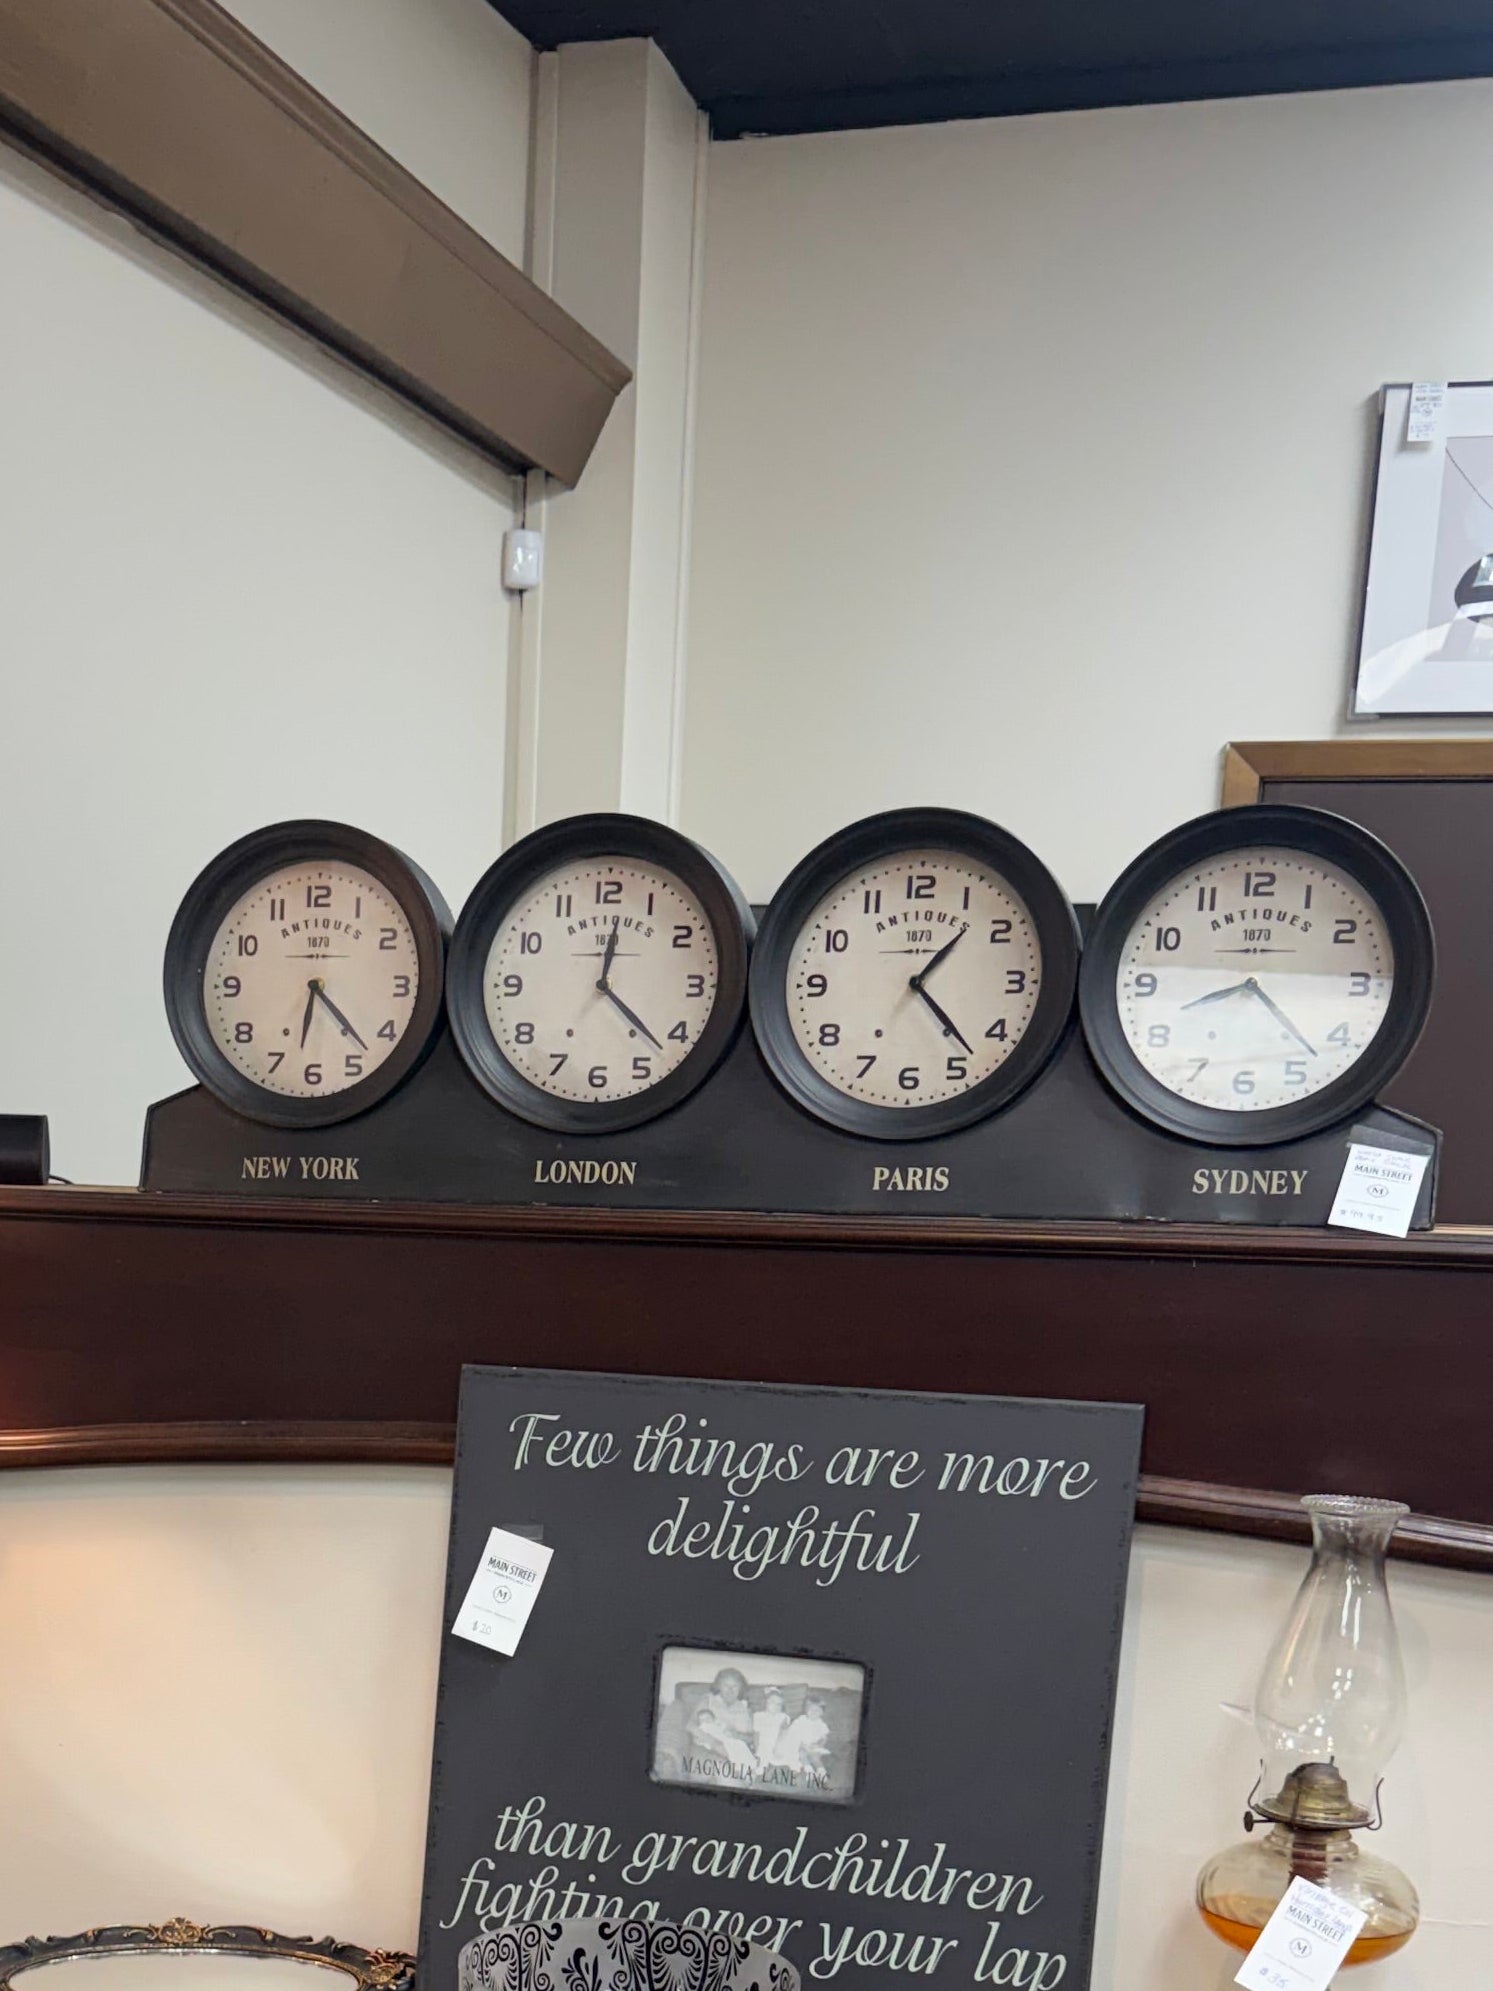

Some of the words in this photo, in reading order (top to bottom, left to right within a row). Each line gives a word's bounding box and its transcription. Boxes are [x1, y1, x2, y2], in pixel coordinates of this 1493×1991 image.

[306, 885, 332, 908] 12
[595, 881, 623, 904] 12
[906, 875, 937, 900] 12
[1243, 872, 1277, 897] 12
[355, 896, 361, 919] 1
[555, 894, 572, 918] 11
[647, 892, 654, 916] 1
[863, 889, 882, 914] 11
[962, 886, 970, 910] 1
[1197, 886, 1217, 912] 11
[1304, 884, 1313, 910] 1
[270, 898, 285, 921] 11
[875, 909, 971, 934] ANTIQUES
[1211, 908, 1313, 933] ANTIQUES
[280, 918, 363, 941] ANTIQUES
[379, 927, 398, 950] 2
[567, 915, 655, 938] ANTIQUES
[672, 925, 693, 949] 2
[990, 919, 1013, 944] 2
[1332, 919, 1357, 944] 2
[238, 934, 259, 957] 10
[520, 931, 542, 954] 10
[825, 929, 849, 953] 10
[1155, 927, 1181, 952] 10
[223, 975, 242, 998] 9
[392, 975, 411, 998] 3
[503, 974, 523, 997] 9
[686, 974, 706, 998] 3
[806, 974, 828, 998] 9
[1004, 970, 1026, 994] 3
[1134, 973, 1158, 998] 9
[1348, 972, 1372, 997] 3
[234, 1022, 254, 1043] 8
[377, 1019, 397, 1042] 4
[514, 1022, 535, 1044] 8
[667, 1021, 689, 1044] 4
[818, 1023, 841, 1046] 8
[984, 1018, 1008, 1042] 4
[1147, 1024, 1171, 1048] 8
[1326, 1021, 1351, 1047] 4
[267, 1052, 285, 1074] 7
[304, 1063, 323, 1085] 6
[344, 1055, 363, 1077] 5
[549, 1053, 569, 1076] 7
[631, 1057, 652, 1080] 5
[856, 1055, 877, 1079] 7
[946, 1056, 968, 1081] 5
[1187, 1058, 1210, 1083] 7
[1284, 1061, 1308, 1086] 5
[588, 1066, 608, 1088] 6
[898, 1067, 920, 1091] 6
[1232, 1070, 1255, 1095] 6
[241, 1157, 291, 1179] NEW
[299, 1157, 360, 1181] YORK
[534, 1160, 638, 1186] LONDON
[871, 1167, 950, 1192] PARIS
[1354, 1164, 1379, 1175] MAIN
[1381, 1169, 1413, 1181] STREET
[1191, 1169, 1309, 1196] SYDNEY
[509, 1413, 622, 1470] Few
[632, 1412, 814, 1498] things
[824, 1438, 925, 1490] are
[936, 1450, 1098, 1501] more
[646, 1496, 921, 1588] delightful
[488, 1556, 509, 1573] MAIN
[510, 1565, 537, 1583] STREET
[682, 1755, 753, 1781] MAGNOLIA
[761, 1764, 797, 1788] LANE
[805, 1771, 834, 1792] INC.
[493, 1795, 622, 1864] than
[621, 1826, 1044, 1916] grandchildren
[1288, 1905, 1312, 1925] MAIN
[1312, 1918, 1344, 1942] STREET
[808, 1922, 959, 1980] your
[973, 1921, 1067, 1991] lap
